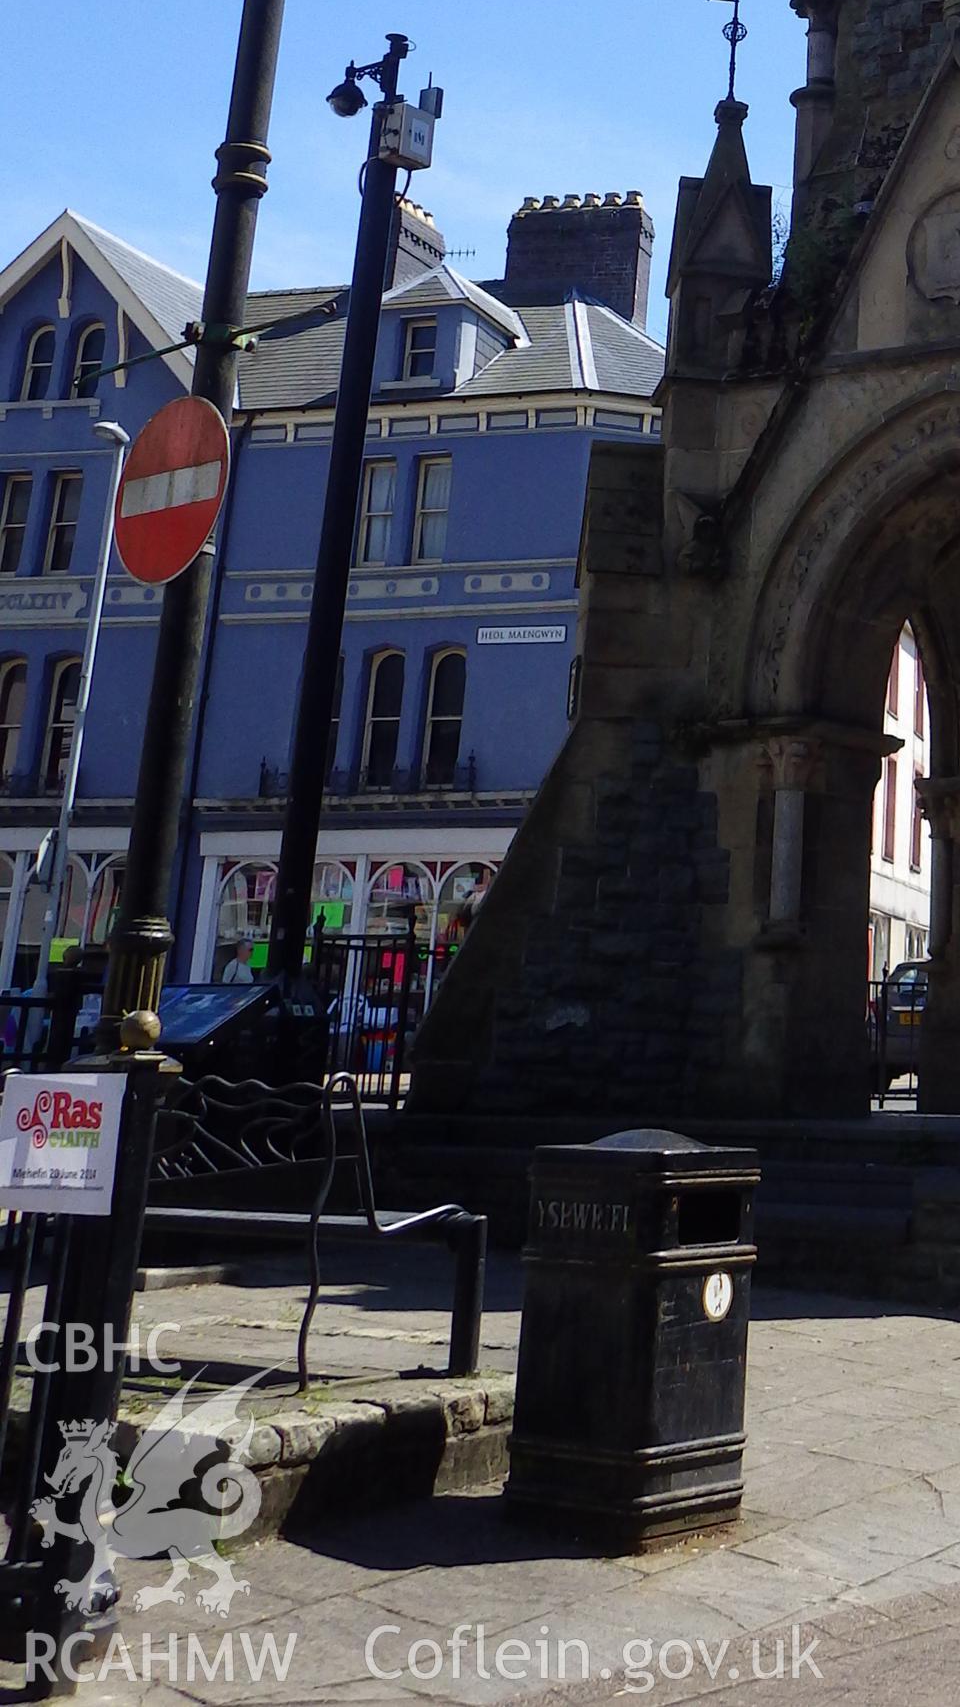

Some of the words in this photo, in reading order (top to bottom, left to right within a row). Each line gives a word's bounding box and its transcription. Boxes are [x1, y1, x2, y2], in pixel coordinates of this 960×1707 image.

[480, 631, 504, 640] HEOL
[508, 629, 562, 639] MAENGWYN
[51, 1092, 103, 1129] Ras
